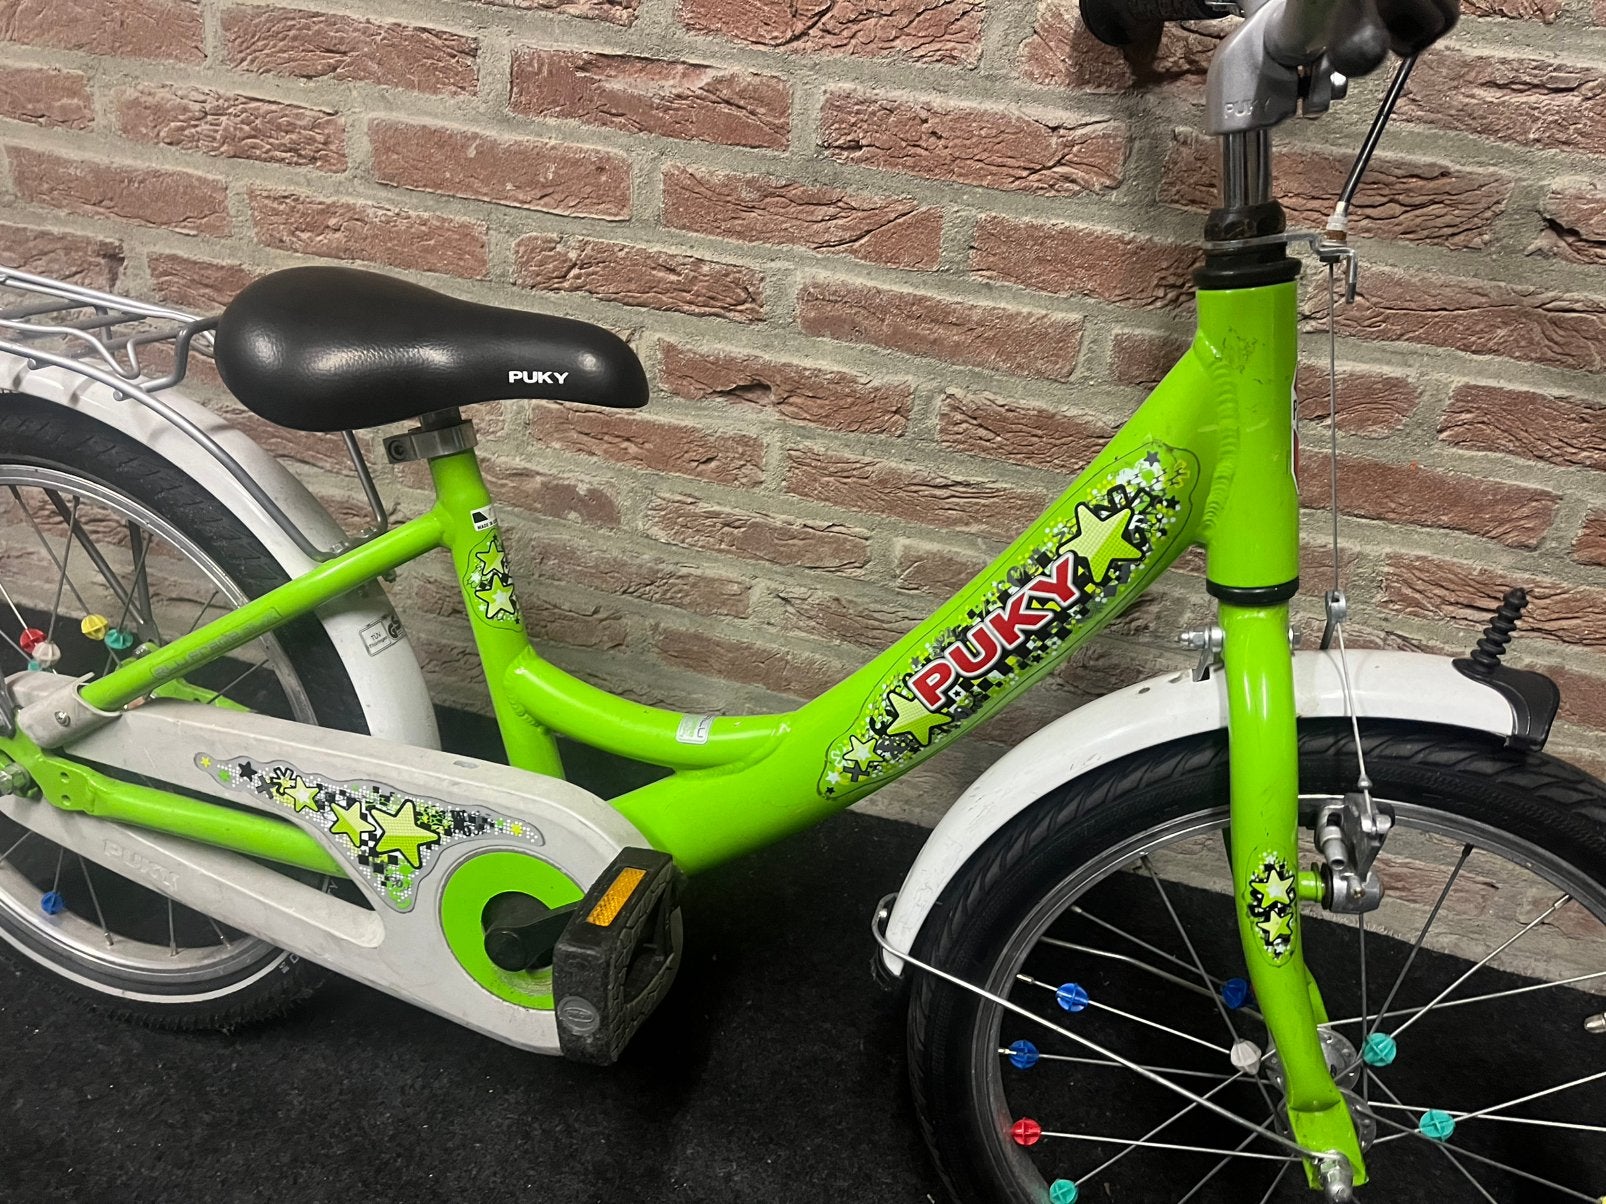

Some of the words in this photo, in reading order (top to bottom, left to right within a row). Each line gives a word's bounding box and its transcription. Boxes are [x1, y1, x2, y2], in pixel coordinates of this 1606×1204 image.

[508, 370, 569, 384] PUKY
[908, 552, 1080, 711] PUKY
[104, 839, 179, 892] PUKY
